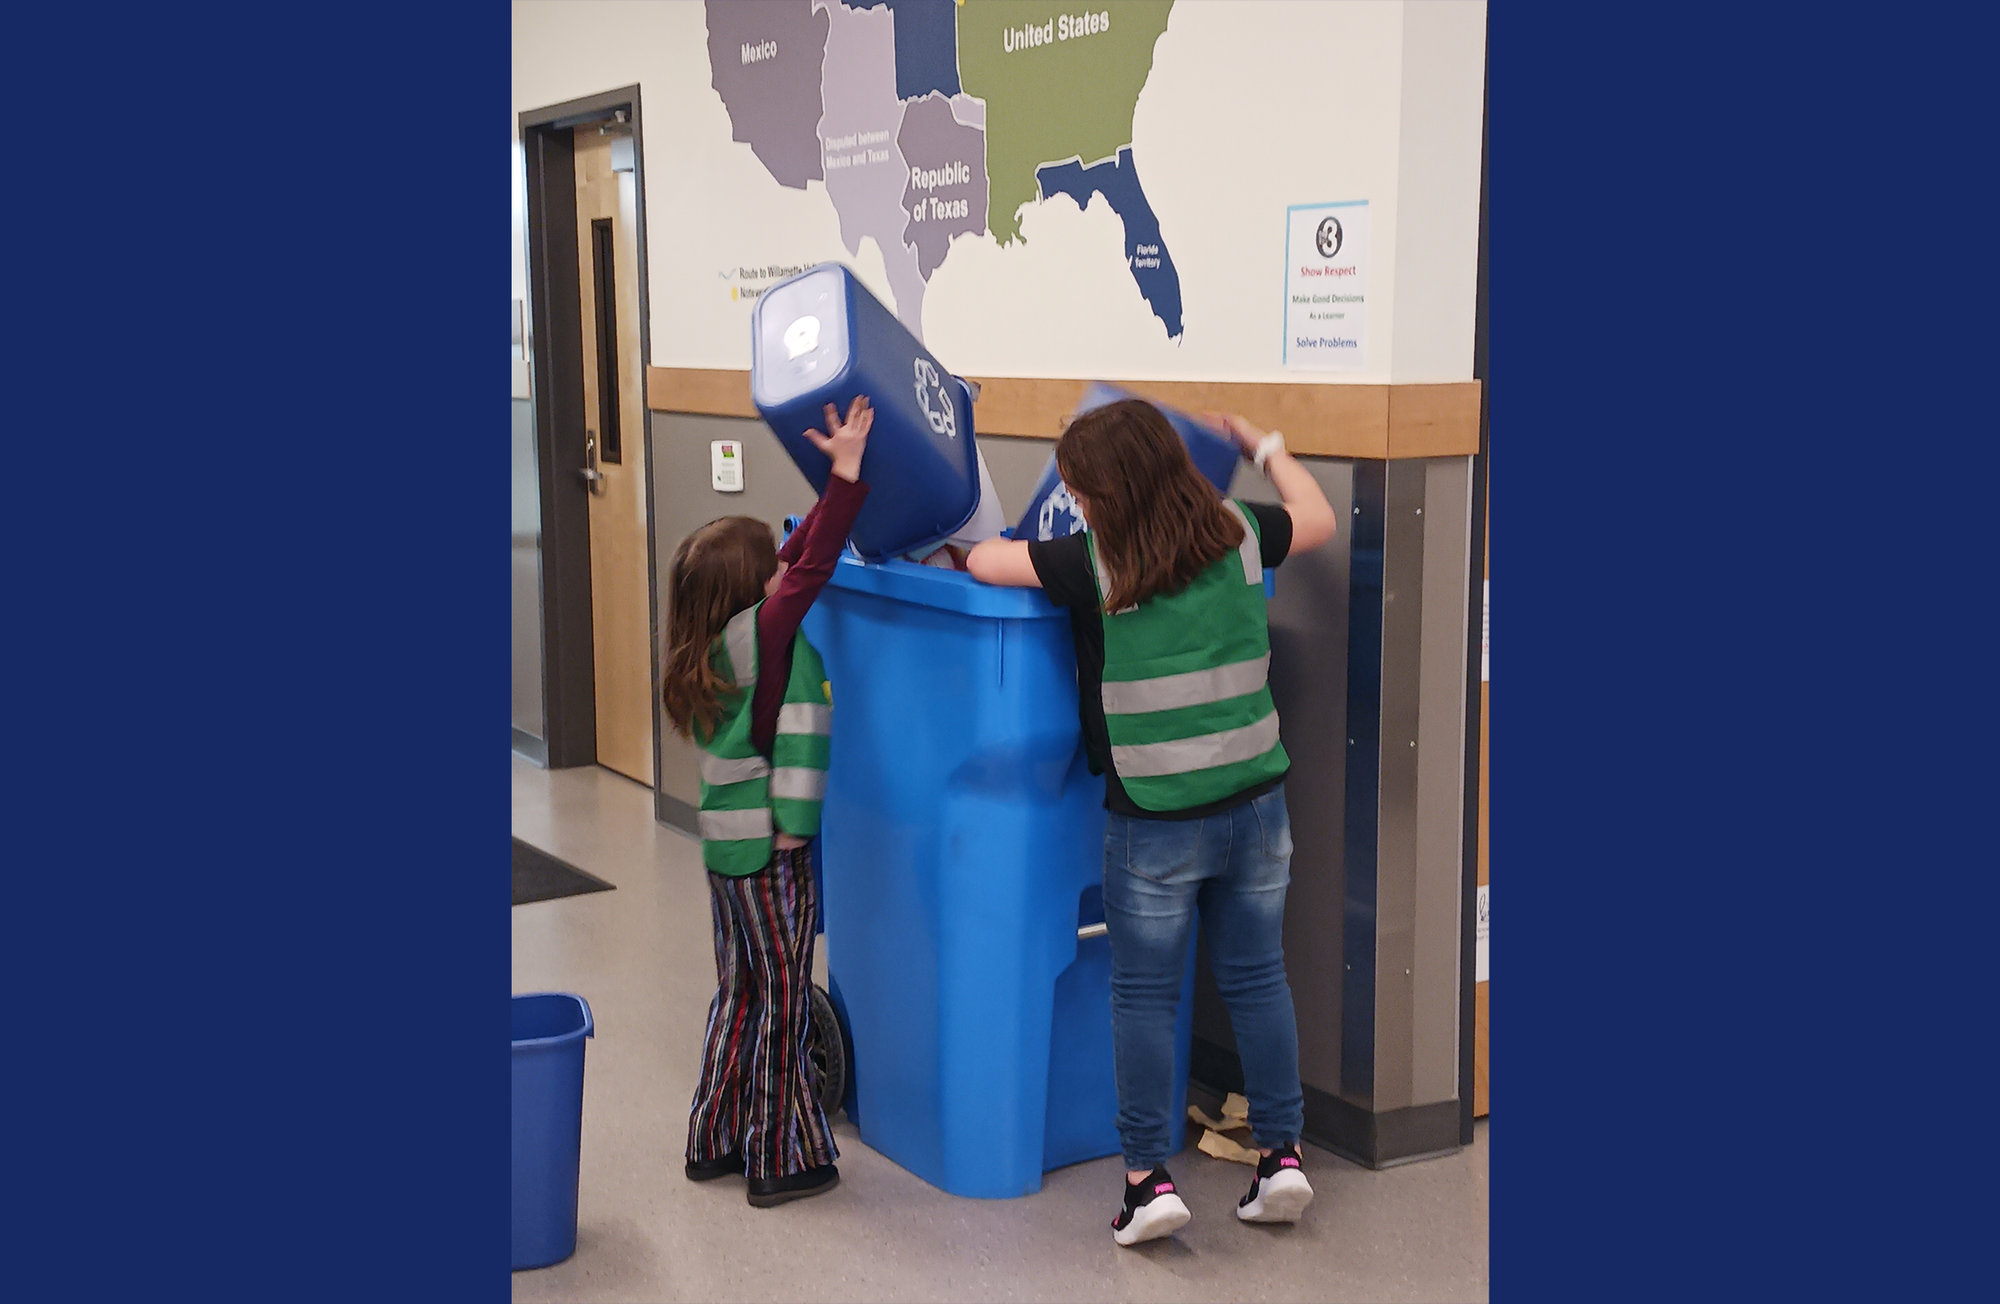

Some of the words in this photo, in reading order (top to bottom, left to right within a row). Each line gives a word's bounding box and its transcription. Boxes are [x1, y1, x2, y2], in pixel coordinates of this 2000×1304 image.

[1003, 17, 1053, 53] United
[1058, 9, 1109, 41] States
[741, 38, 777, 65] Mexico
[825, 132, 857, 151] Disputed
[858, 130, 889, 146] between
[826, 153, 851, 169] Mexico
[852, 150, 866, 165] and
[867, 149, 889, 164] Texas
[911, 160, 970, 193] Republic
[913, 197, 927, 223] of
[929, 197, 969, 220] Texas
[739, 266, 758, 280] Route
[760, 266, 767, 279] to
[1300, 265, 1322, 278] Show
[1324, 265, 1356, 279] Respect
[1292, 294, 1311, 304] Make
[1312, 293, 1331, 304] Good
[1331, 293, 1364, 304] Decisions
[1309, 311, 1317, 320] As
[1317, 312, 1322, 320] a
[1296, 336, 1318, 349] Solve
[1319, 336, 1358, 349] Problems
